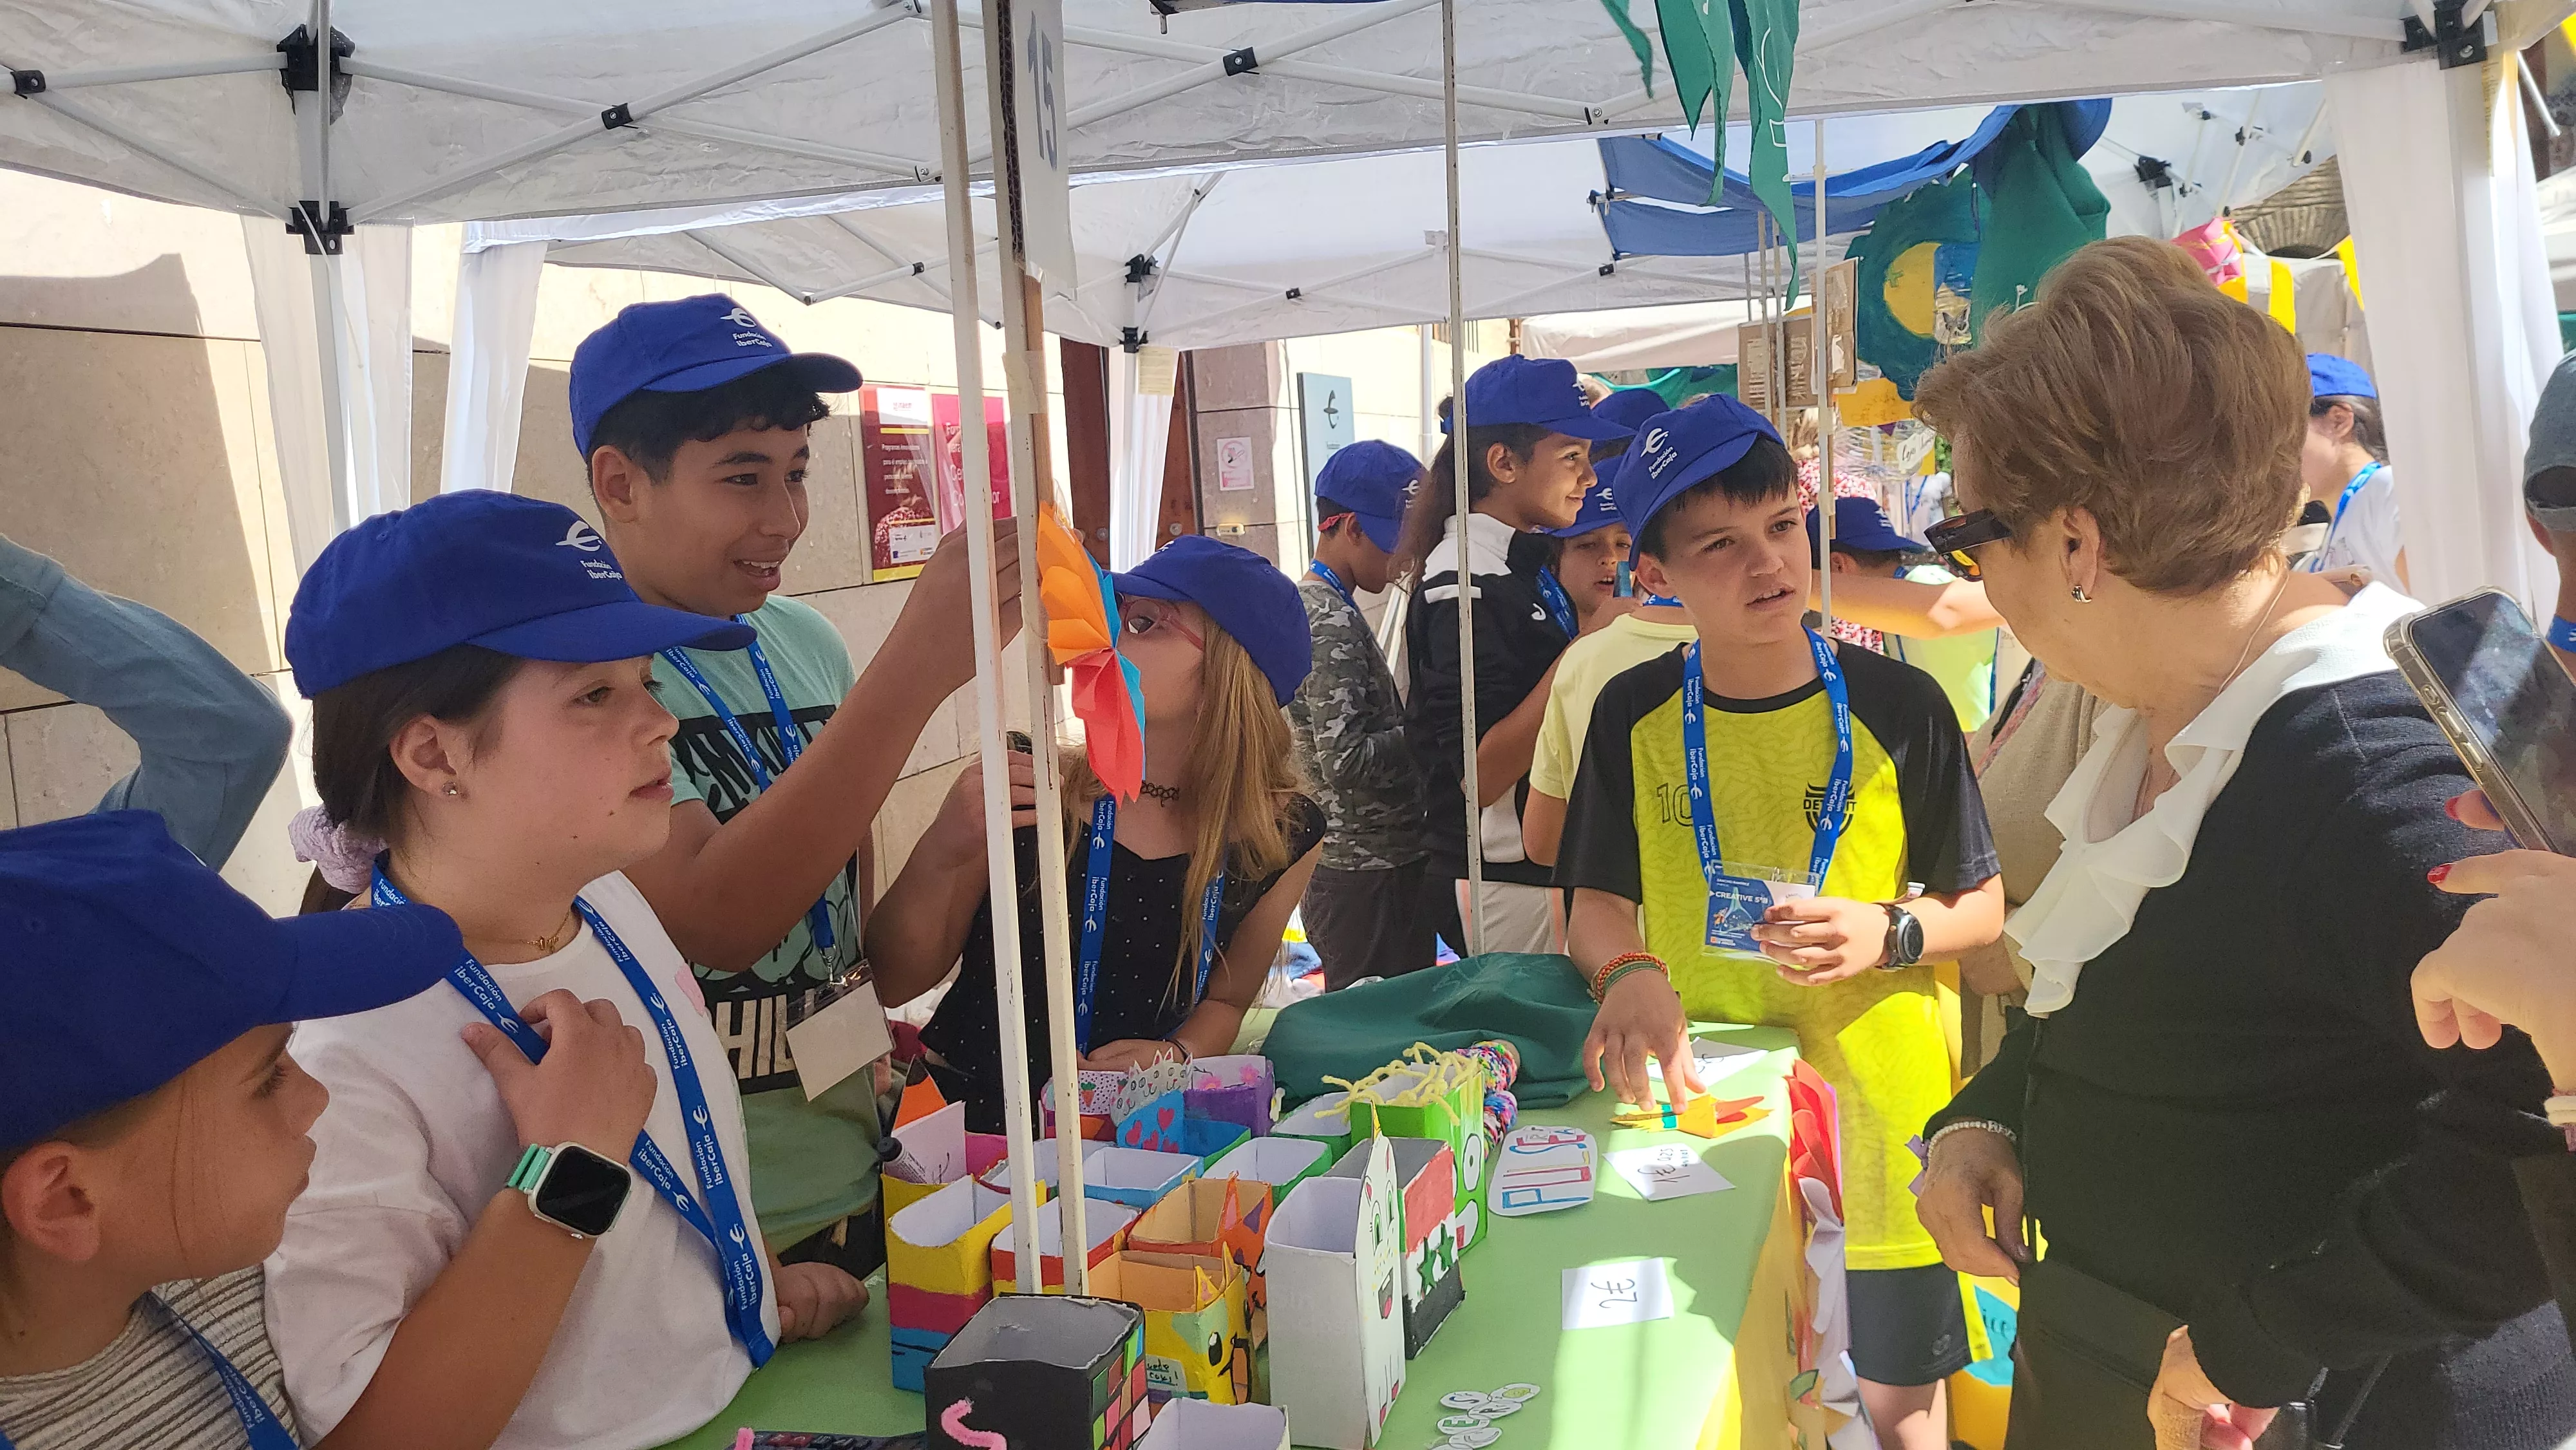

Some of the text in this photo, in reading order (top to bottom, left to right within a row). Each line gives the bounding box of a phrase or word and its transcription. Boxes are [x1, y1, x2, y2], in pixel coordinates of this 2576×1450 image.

[1027, 10, 1057, 172] 15
[379, 878, 406, 905] Fundació
[1715, 891, 1753, 901] CREATIVE
[453, 966, 497, 1011] iberCaja
[466, 958, 502, 1003] Fundación
[637, 1147, 672, 1191] iberCaja
[703, 1134, 724, 1185] iberCaja
[1590, 1278, 1638, 1309] 2€
